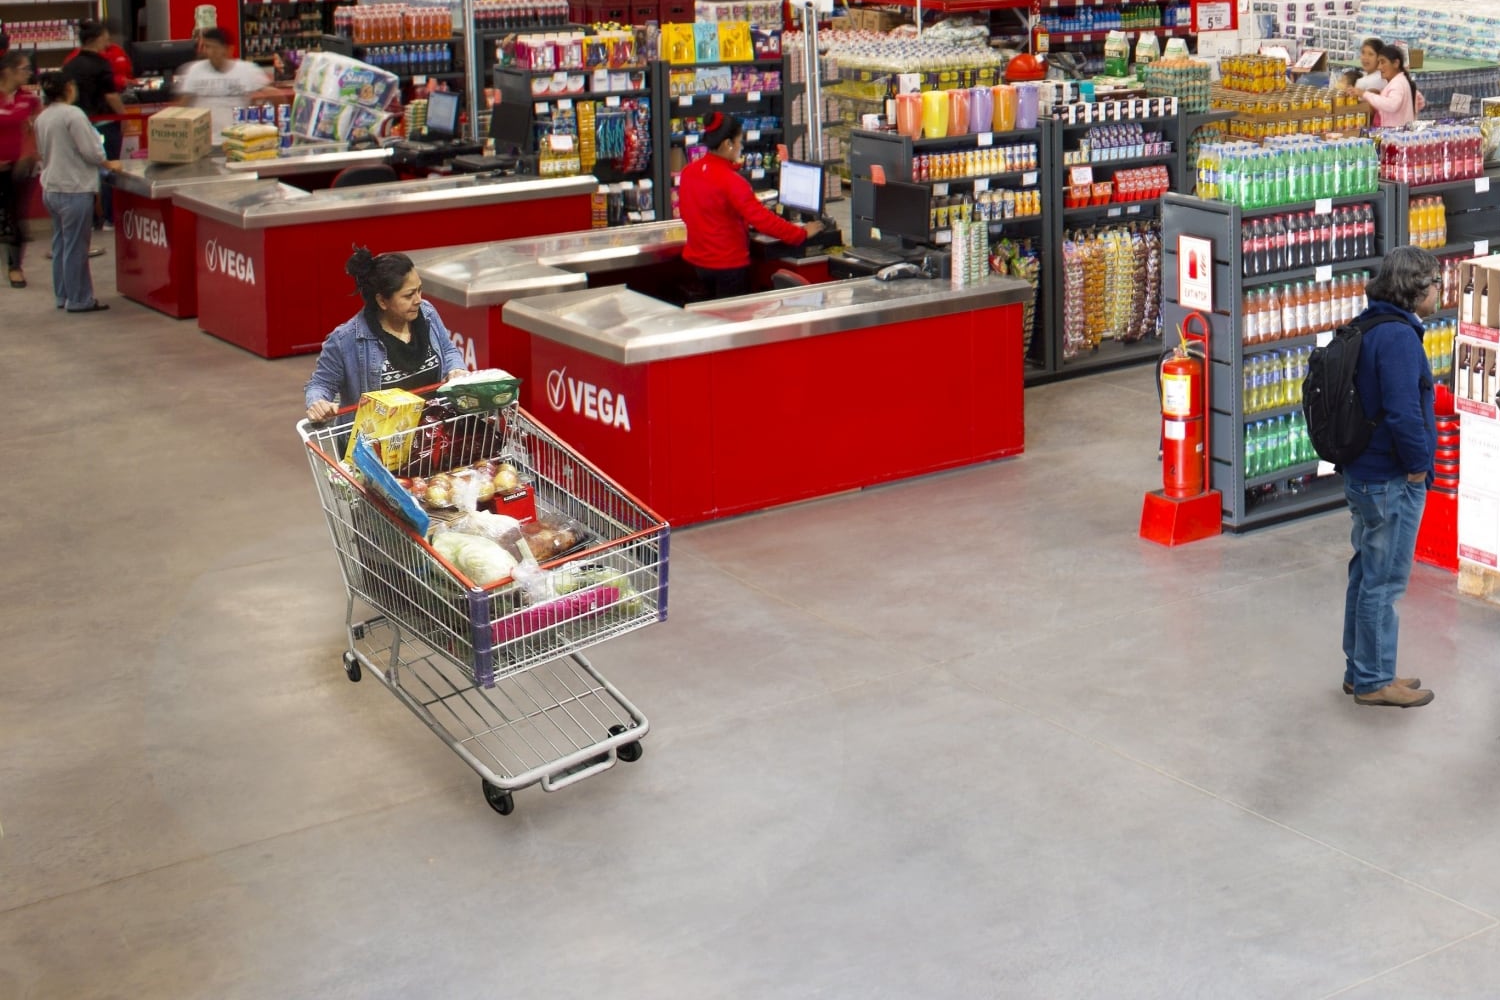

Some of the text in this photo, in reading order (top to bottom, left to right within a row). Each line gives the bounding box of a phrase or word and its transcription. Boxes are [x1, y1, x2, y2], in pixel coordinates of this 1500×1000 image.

[151, 128, 188, 140] PRIMOR
[135, 214, 168, 248] VEGA
[219, 246, 256, 286] VEGA
[568, 377, 631, 431] VEGA
